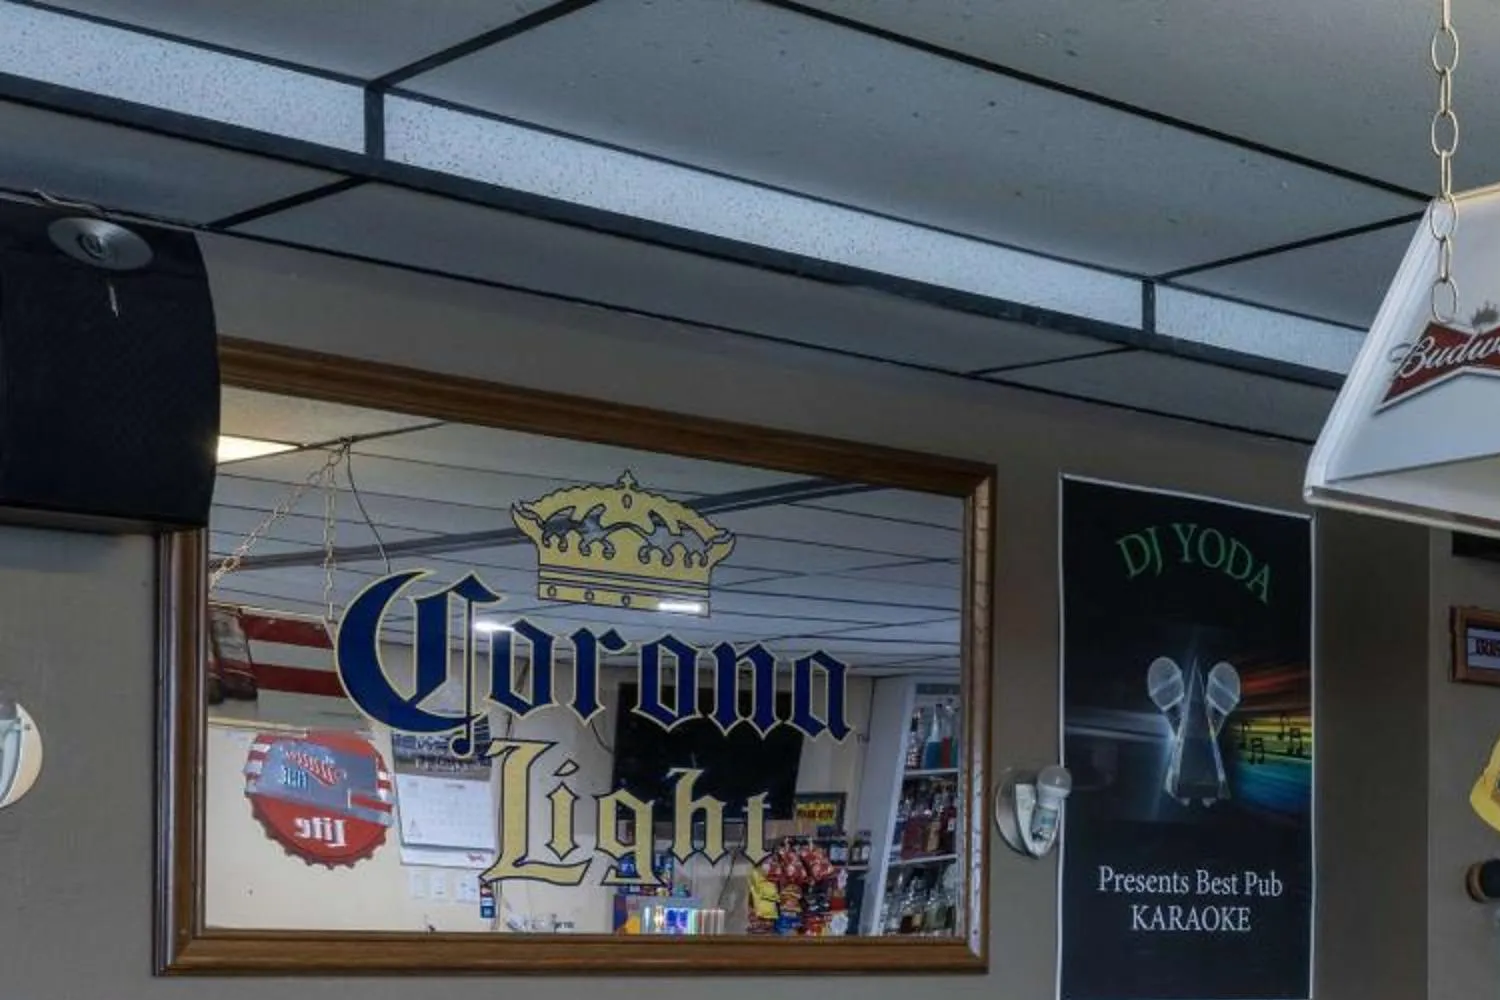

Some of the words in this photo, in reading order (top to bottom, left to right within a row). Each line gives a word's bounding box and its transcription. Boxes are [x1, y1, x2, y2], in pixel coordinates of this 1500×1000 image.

[1115, 524, 1163, 580] DJ
[1171, 521, 1273, 604] YODA
[334, 568, 853, 758] Corona
[479, 738, 774, 889] Light
[1098, 864, 1190, 895] Presents
[1196, 868, 1239, 896] Best
[1244, 870, 1284, 898] Pub
[1130, 903, 1252, 933] KARAOKE
